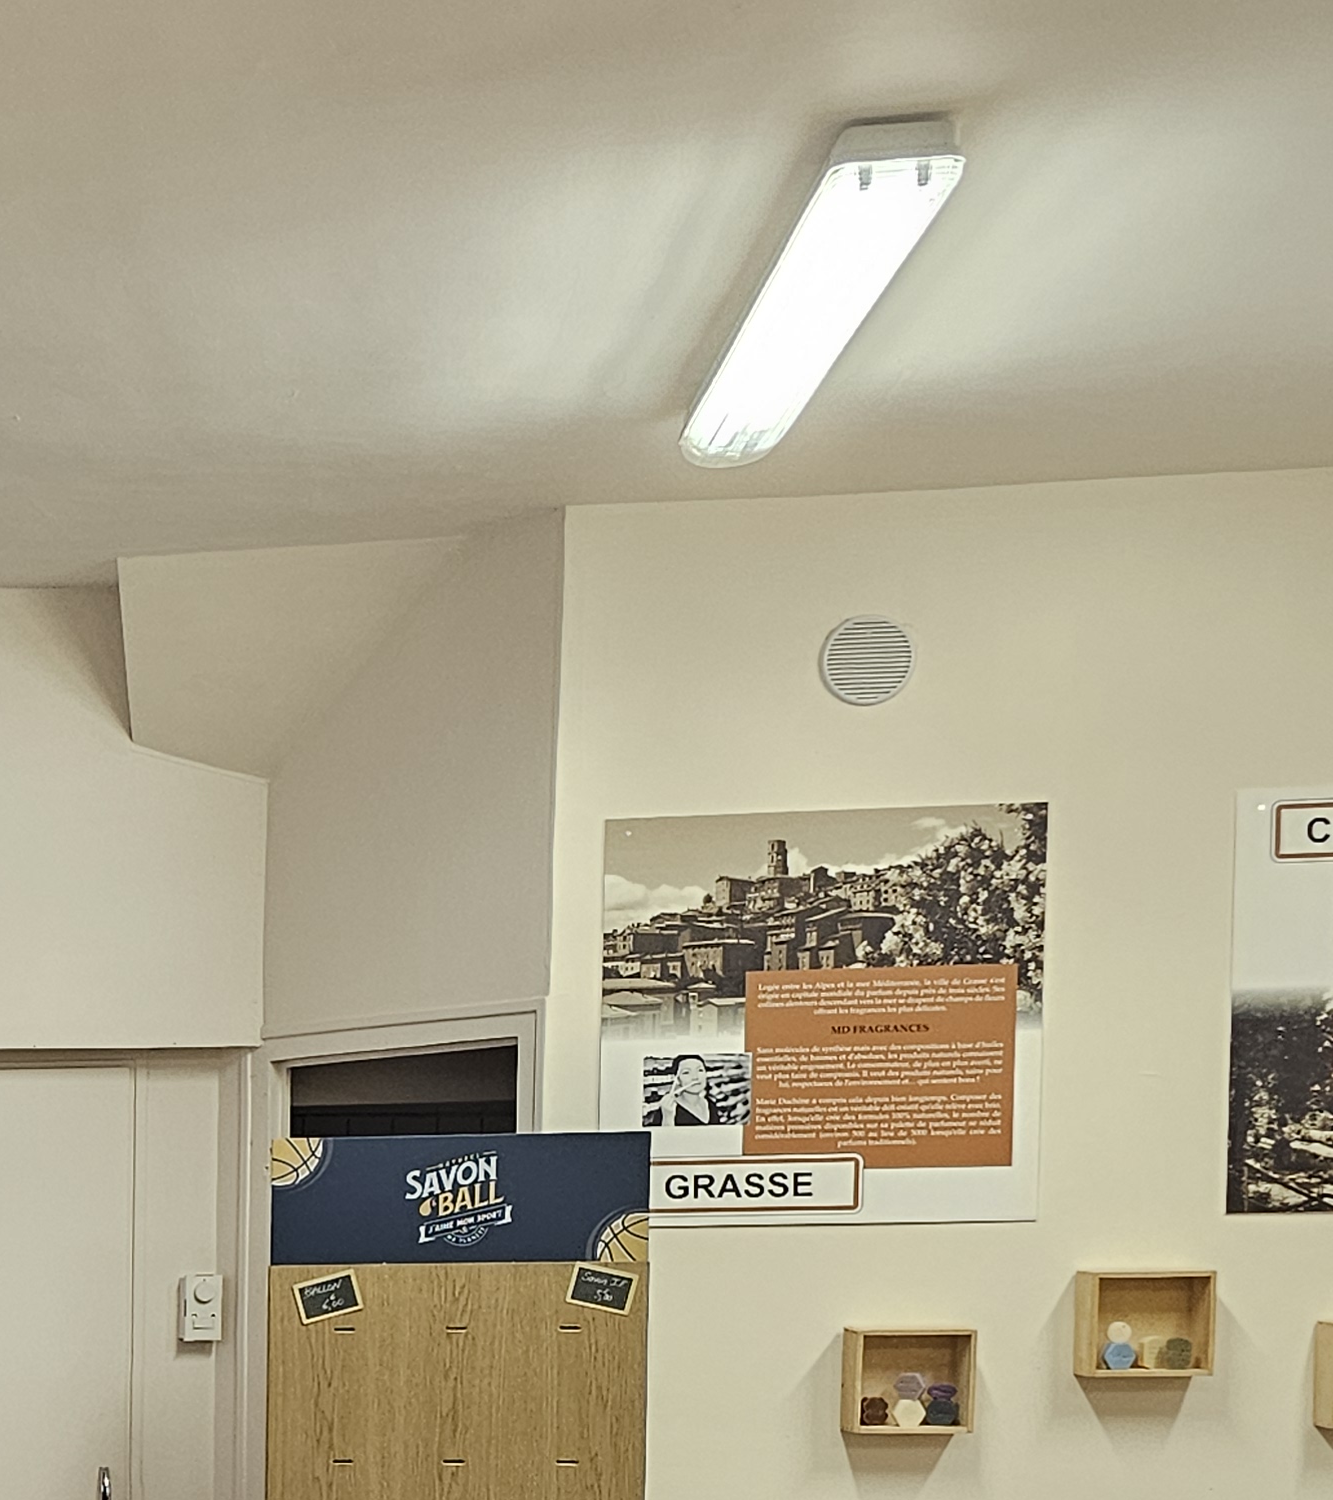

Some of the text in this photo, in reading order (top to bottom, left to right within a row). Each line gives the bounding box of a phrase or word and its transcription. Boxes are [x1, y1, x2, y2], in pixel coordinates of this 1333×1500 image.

[831, 1024, 930, 1034] MD FRAGRANCES
[405, 1155, 498, 1200] SAVON
[665, 1172, 814, 1199] GRASSE
